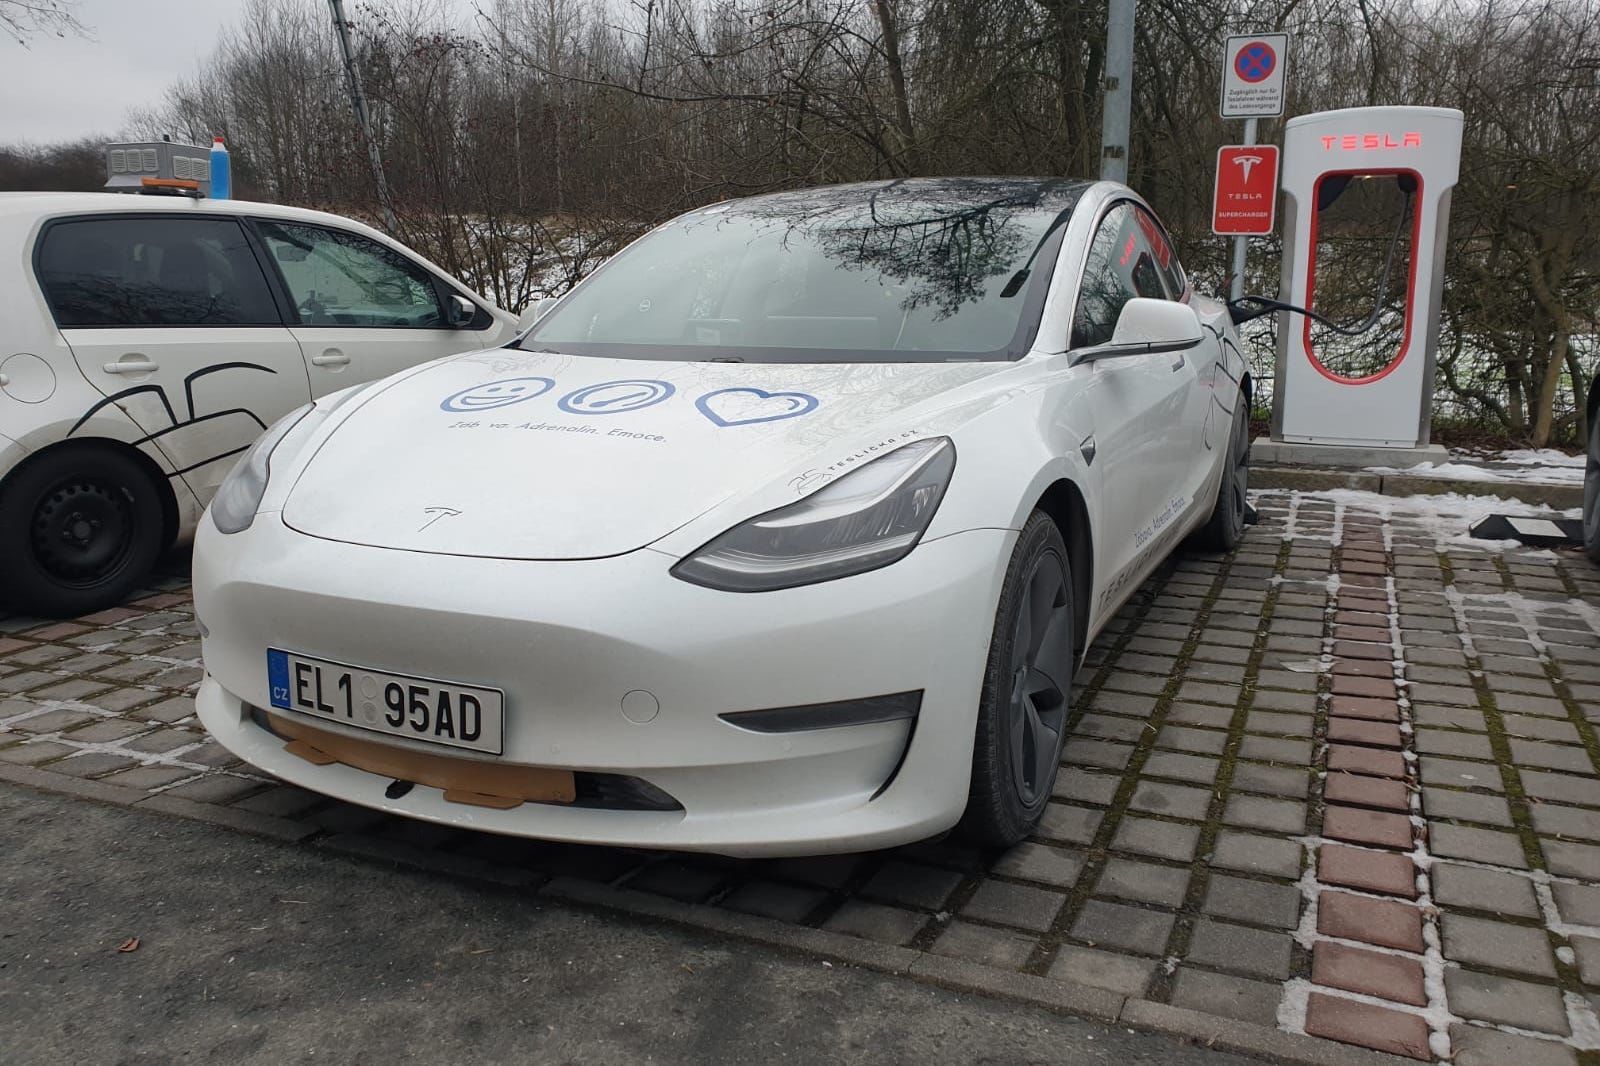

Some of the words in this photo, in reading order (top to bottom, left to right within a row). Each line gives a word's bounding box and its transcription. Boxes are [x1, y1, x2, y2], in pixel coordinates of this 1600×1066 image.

[1321, 132, 1421, 150] TESLA
[515, 421, 599, 435] Adrenalin.
[607, 428, 667, 443] Emoce.
[273, 686, 289, 701] CZ
